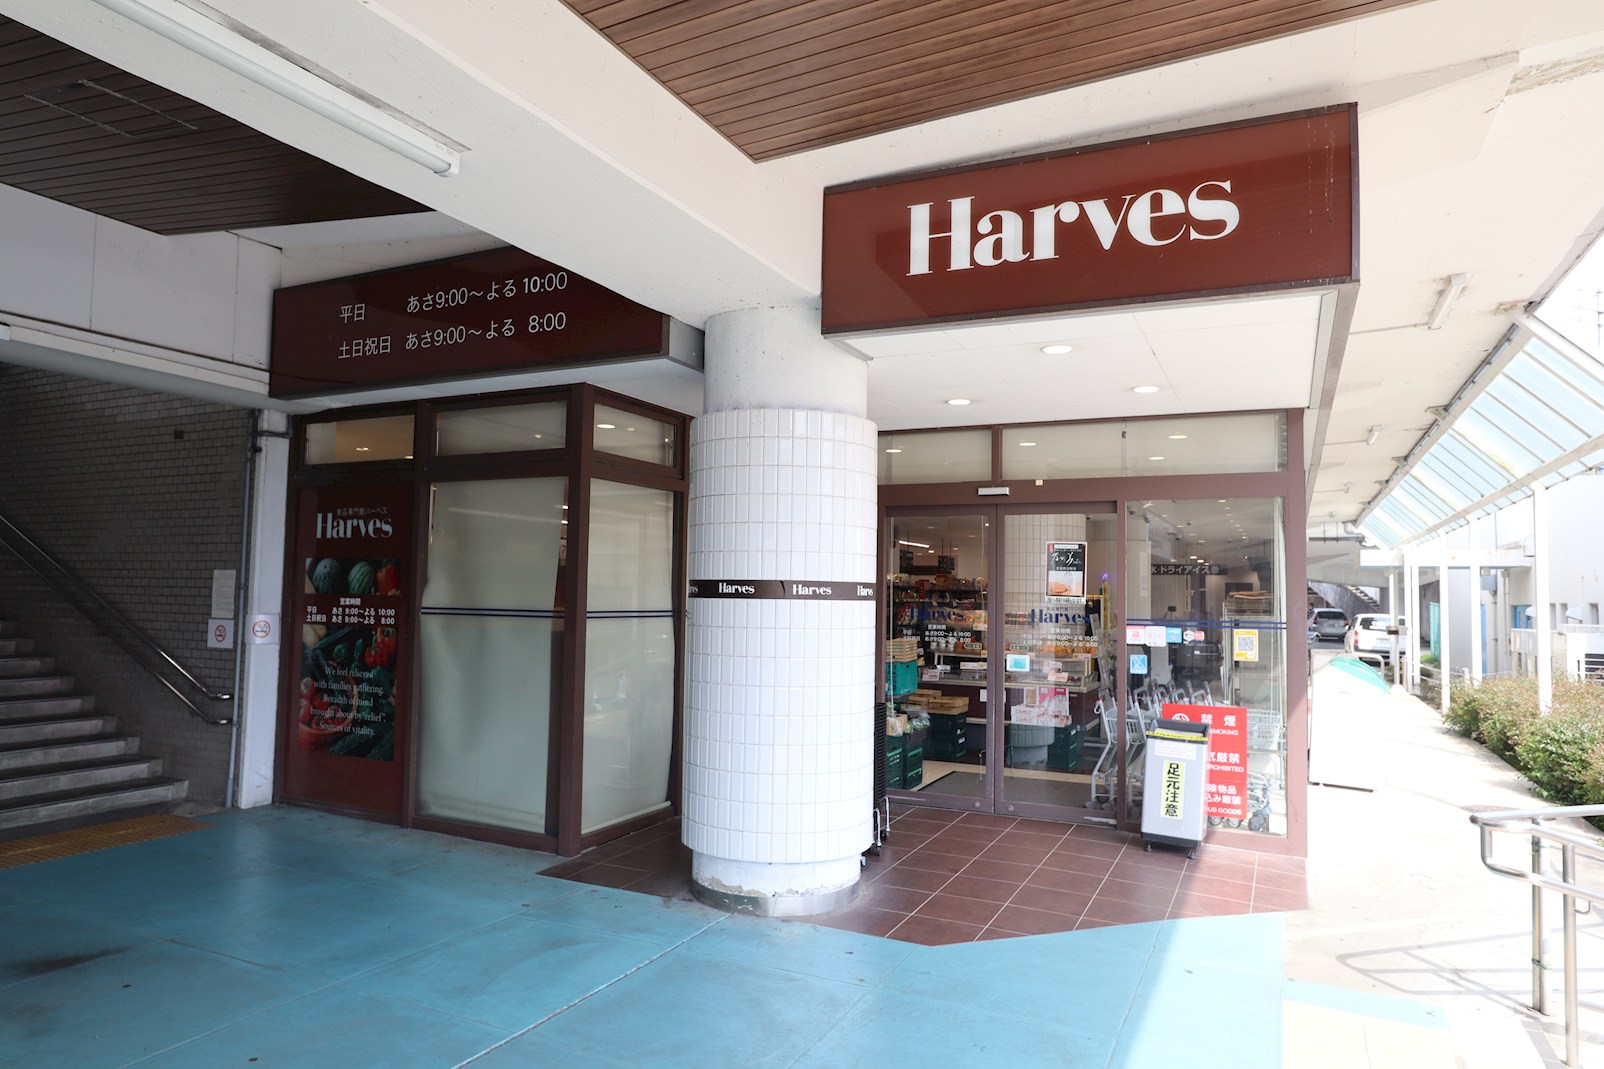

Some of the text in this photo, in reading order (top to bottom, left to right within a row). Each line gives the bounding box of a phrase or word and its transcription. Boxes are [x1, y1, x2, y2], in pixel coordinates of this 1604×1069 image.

[906, 180, 1240, 276] Harves
[339, 303, 366, 324] 平日
[522, 271, 568, 294] 10:00
[337, 335, 392, 360] 土日祝日
[527, 311, 567, 333] 8:00
[316, 512, 393, 539] Harves
[718, 582, 755, 595] Harves
[792, 583, 832, 596] Harves
[339, 597, 361, 606] 営業時間
[306, 606, 317, 614] 平日
[378, 608, 396, 616] 10:00
[306, 614, 327, 622] 土日祝日
[381, 617, 395, 625] 8:00
[325, 665, 335, 676] We
[337, 667, 348, 676] feel
[313, 680, 327, 688] with
[323, 693, 347, 705] Breadth
[310, 706, 334, 719] brought
[335, 708, 353, 719] about
[319, 720, 343, 731] Sources
[344, 723, 351, 733] of
[1165, 762, 1181, 818] 足元注意
[1217, 807, 1242, 816] GOODS
